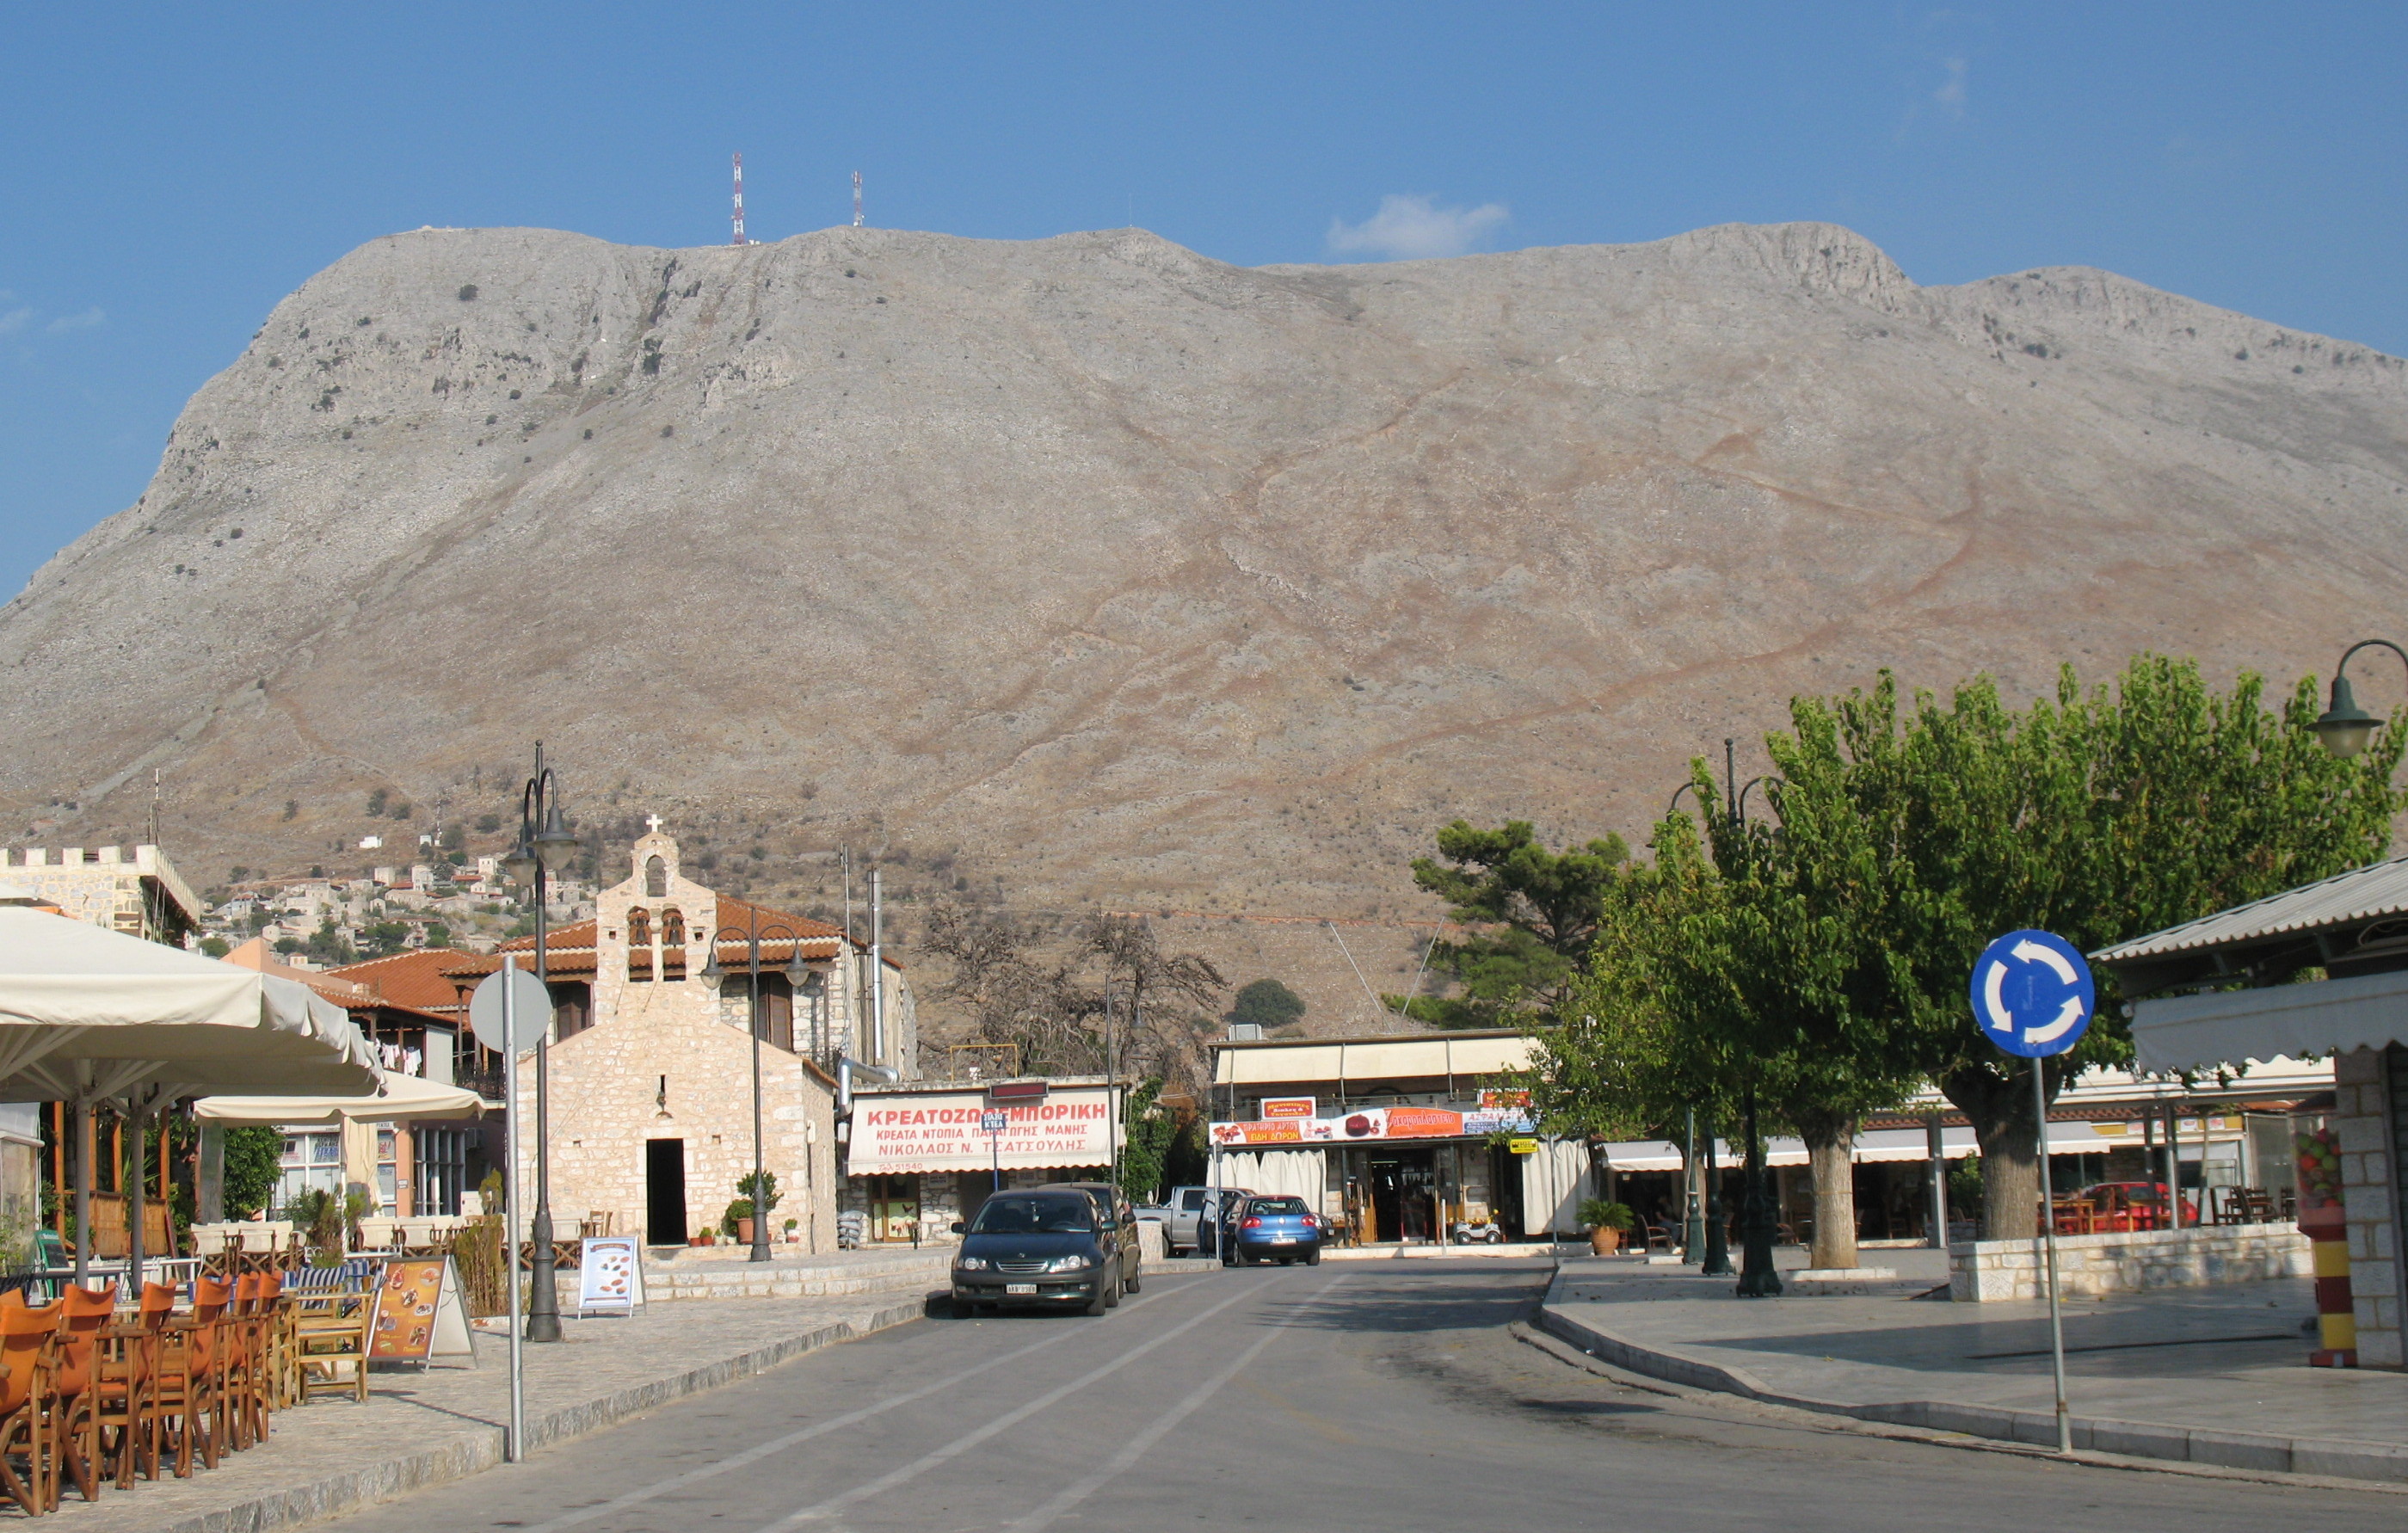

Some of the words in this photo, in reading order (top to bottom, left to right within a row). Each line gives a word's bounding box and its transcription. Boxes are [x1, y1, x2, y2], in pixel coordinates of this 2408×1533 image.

[877, 1129, 917, 1141] ΚΡΕΑΤΑ
[922, 1128, 964, 1139] ΝΤΟΠΙΑ
[1045, 1124, 1088, 1136] ΜΑΝΗΣ
[1271, 1132, 1299, 1141] ΔΩΡΩΝ
[878, 1142, 954, 1156] ΝΙΚΟΛΑΟΣ
[961, 1142, 973, 1153] Ν.
[982, 1139, 1087, 1153] ΤΣΑΤΣΟΥΛΗΣ
